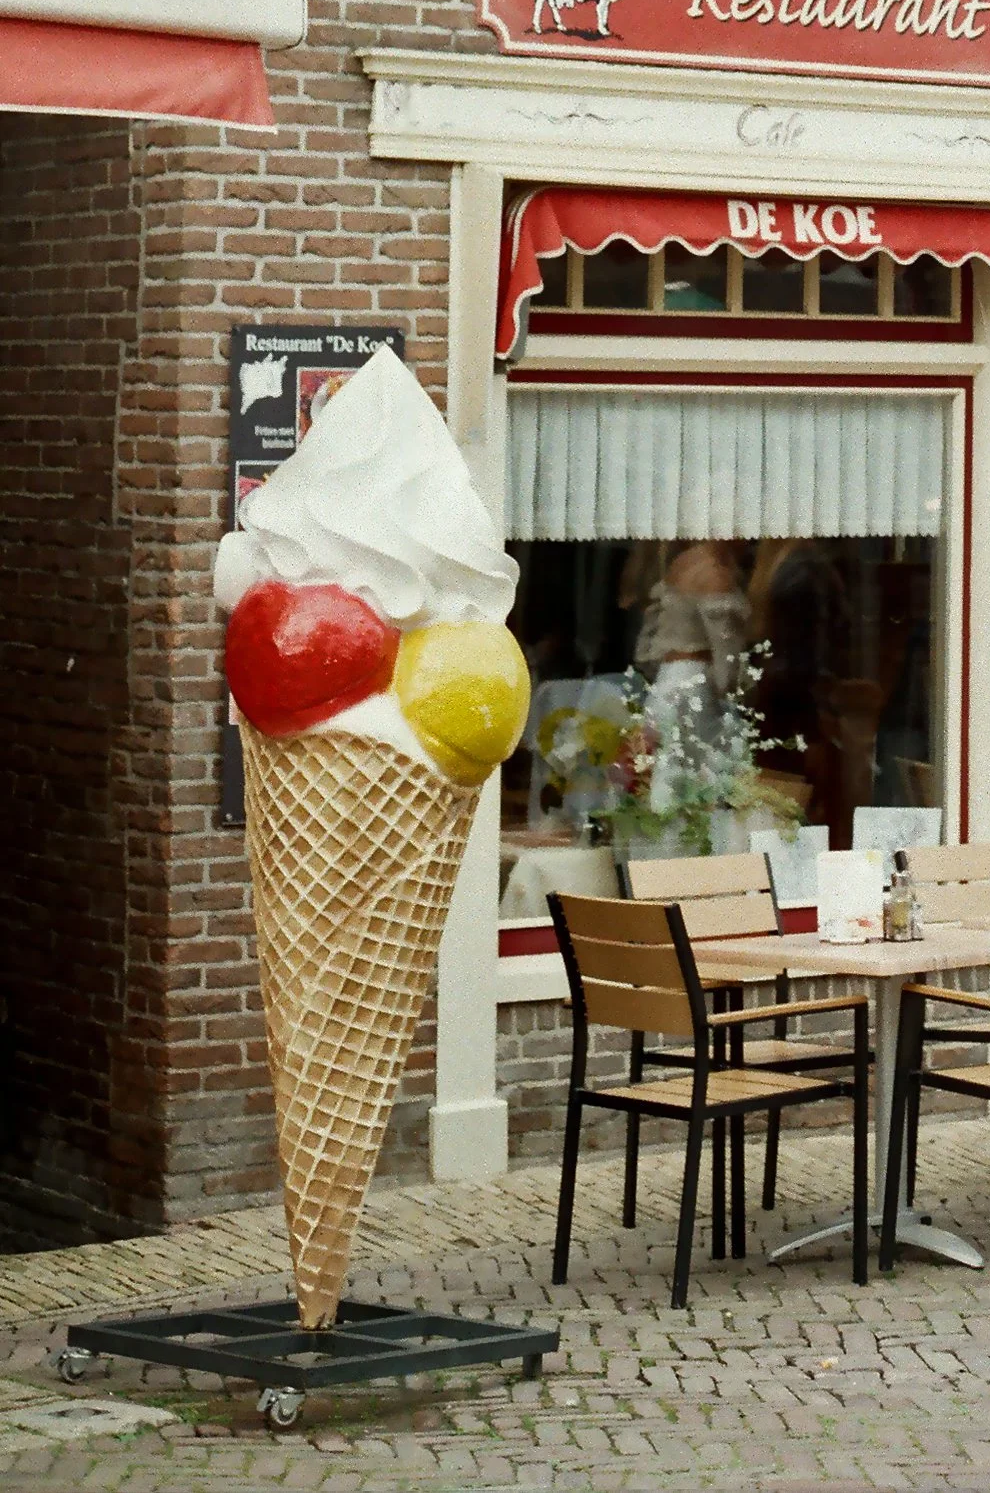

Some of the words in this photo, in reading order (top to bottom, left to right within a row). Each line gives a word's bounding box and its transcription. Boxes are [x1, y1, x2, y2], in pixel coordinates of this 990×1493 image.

[727, 199, 783, 240] DE
[795, 203, 883, 245] KOE
[246, 334, 322, 351] Restaurant
